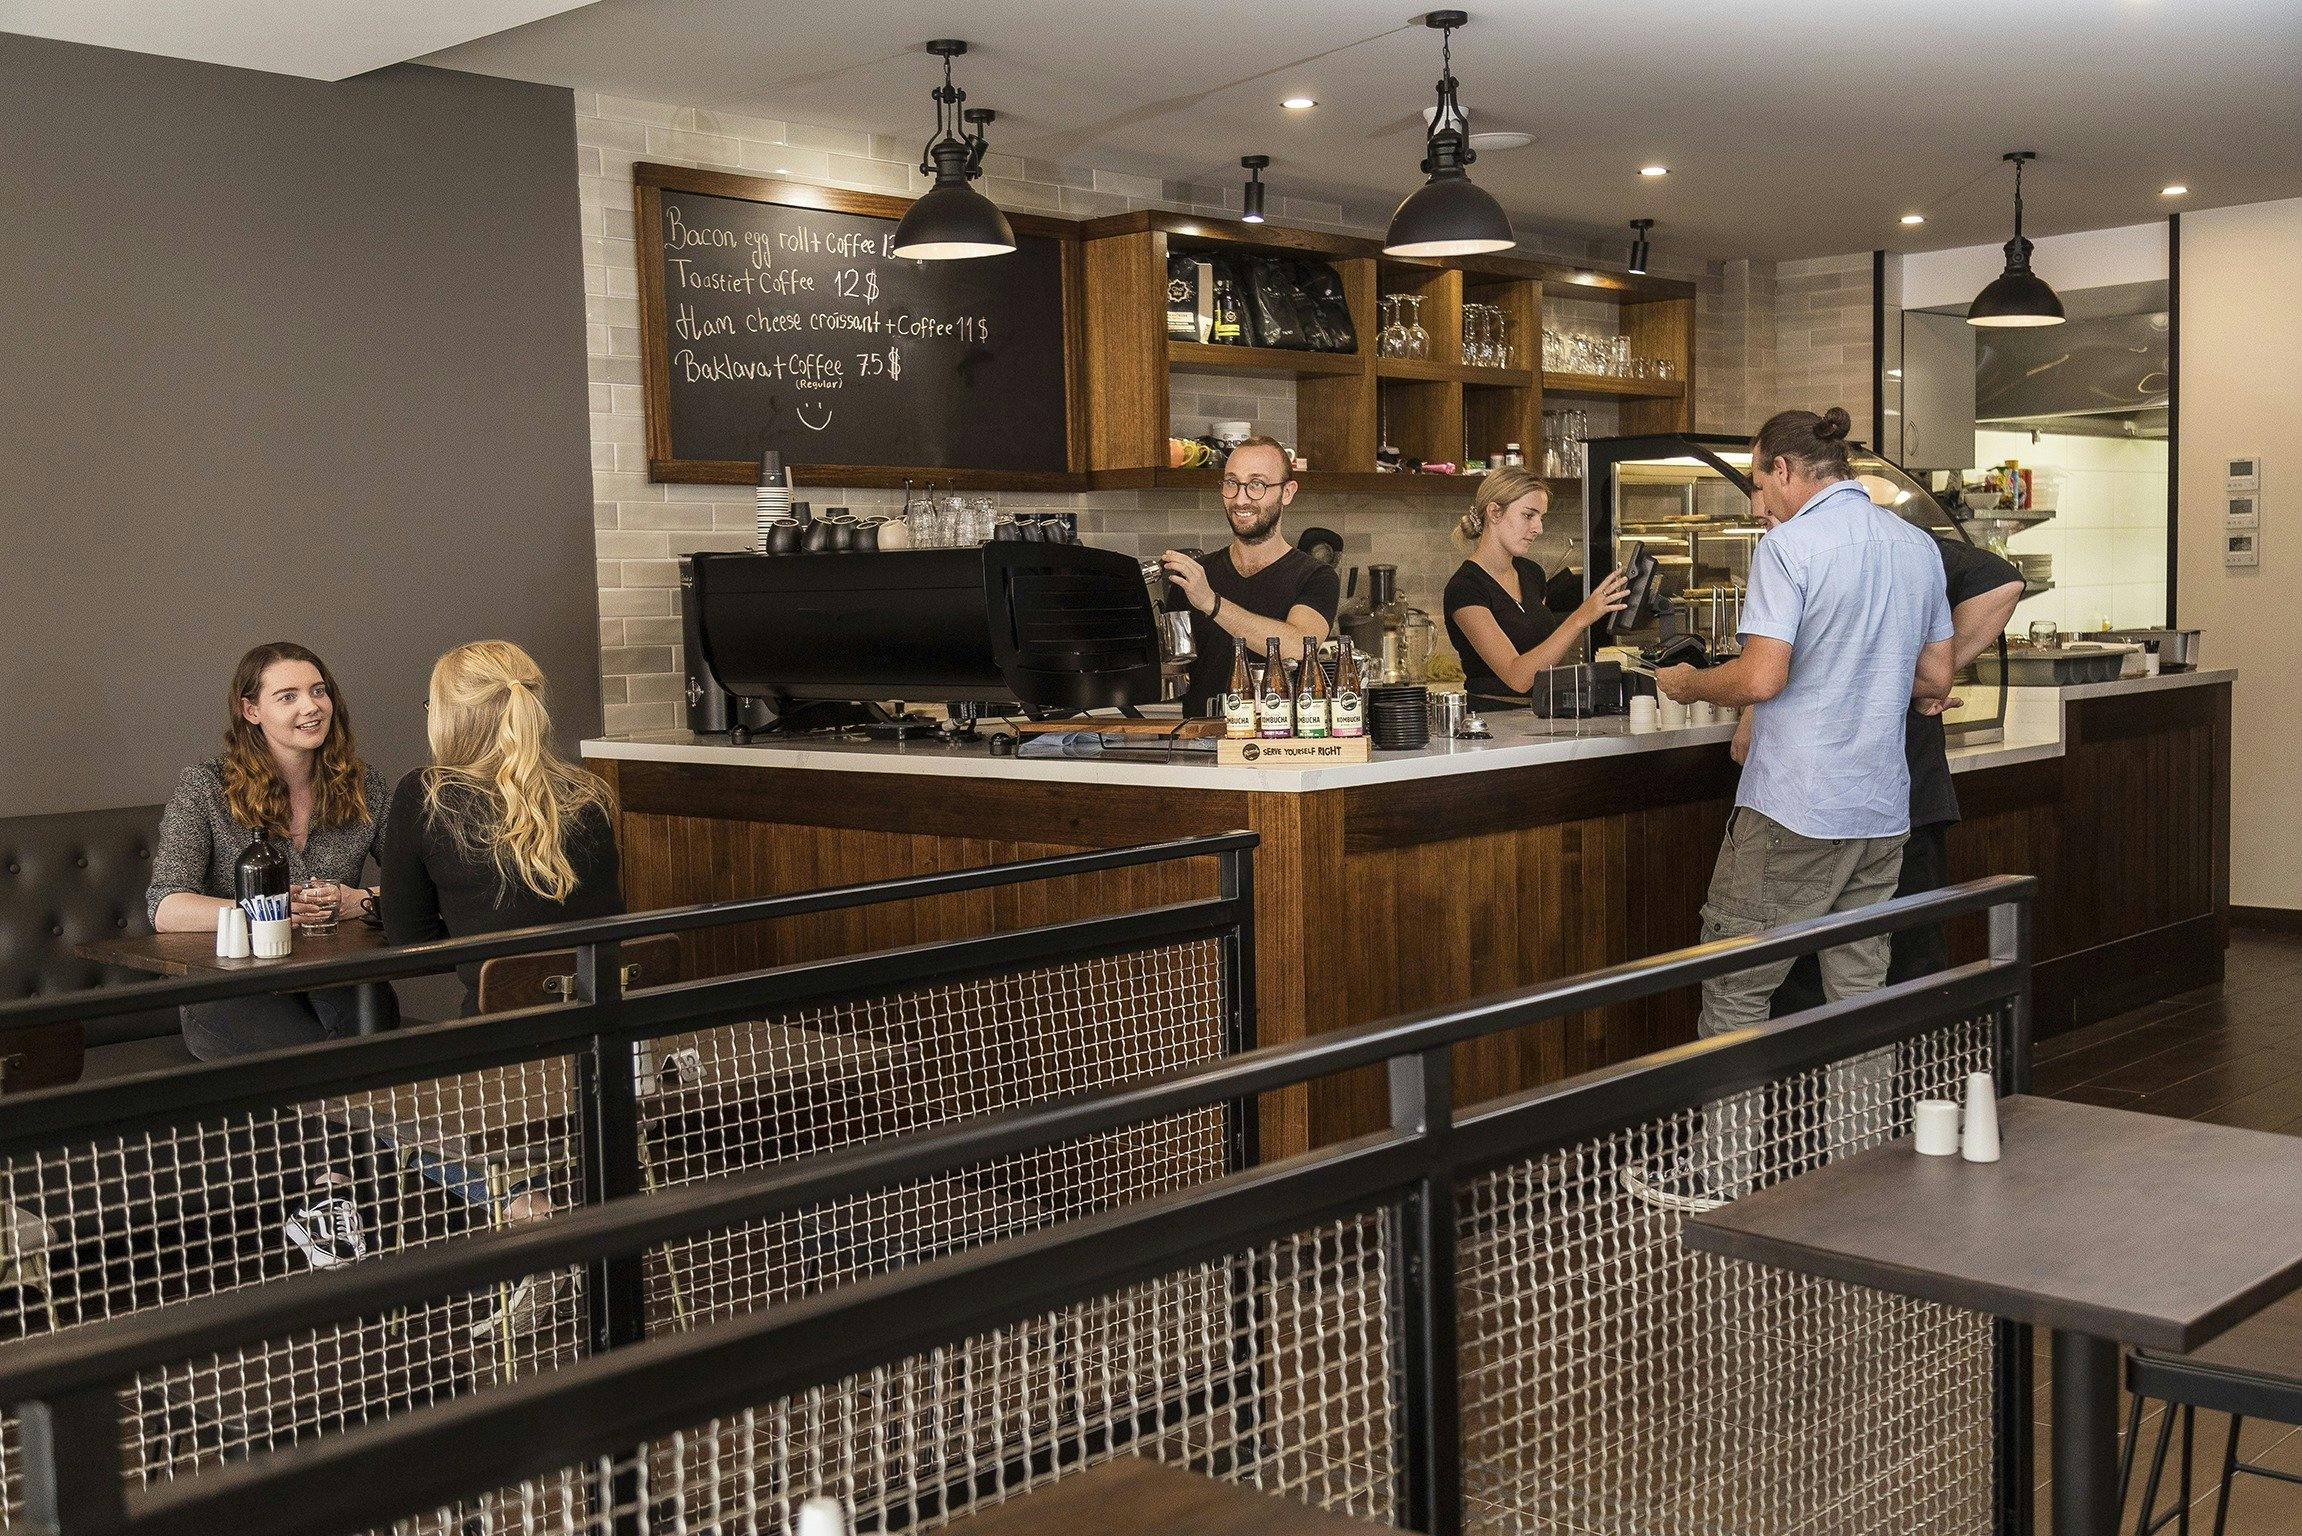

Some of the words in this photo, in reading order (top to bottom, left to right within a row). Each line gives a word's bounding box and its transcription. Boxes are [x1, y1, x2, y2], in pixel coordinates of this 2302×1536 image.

[664, 206, 737, 251] Bacon
[745, 231, 771, 269] egg
[826, 232, 876, 258] Coffee
[759, 268, 815, 296] Coffee
[675, 302, 736, 341] Ham
[746, 307, 801, 333] cheese
[810, 310, 882, 334] croissant
[795, 378, 843, 390] (Regular)
[1262, 748, 1281, 756] SERVE
[1284, 747, 1316, 756] YOURSELF
[1317, 746, 1342, 756] RIGHT
